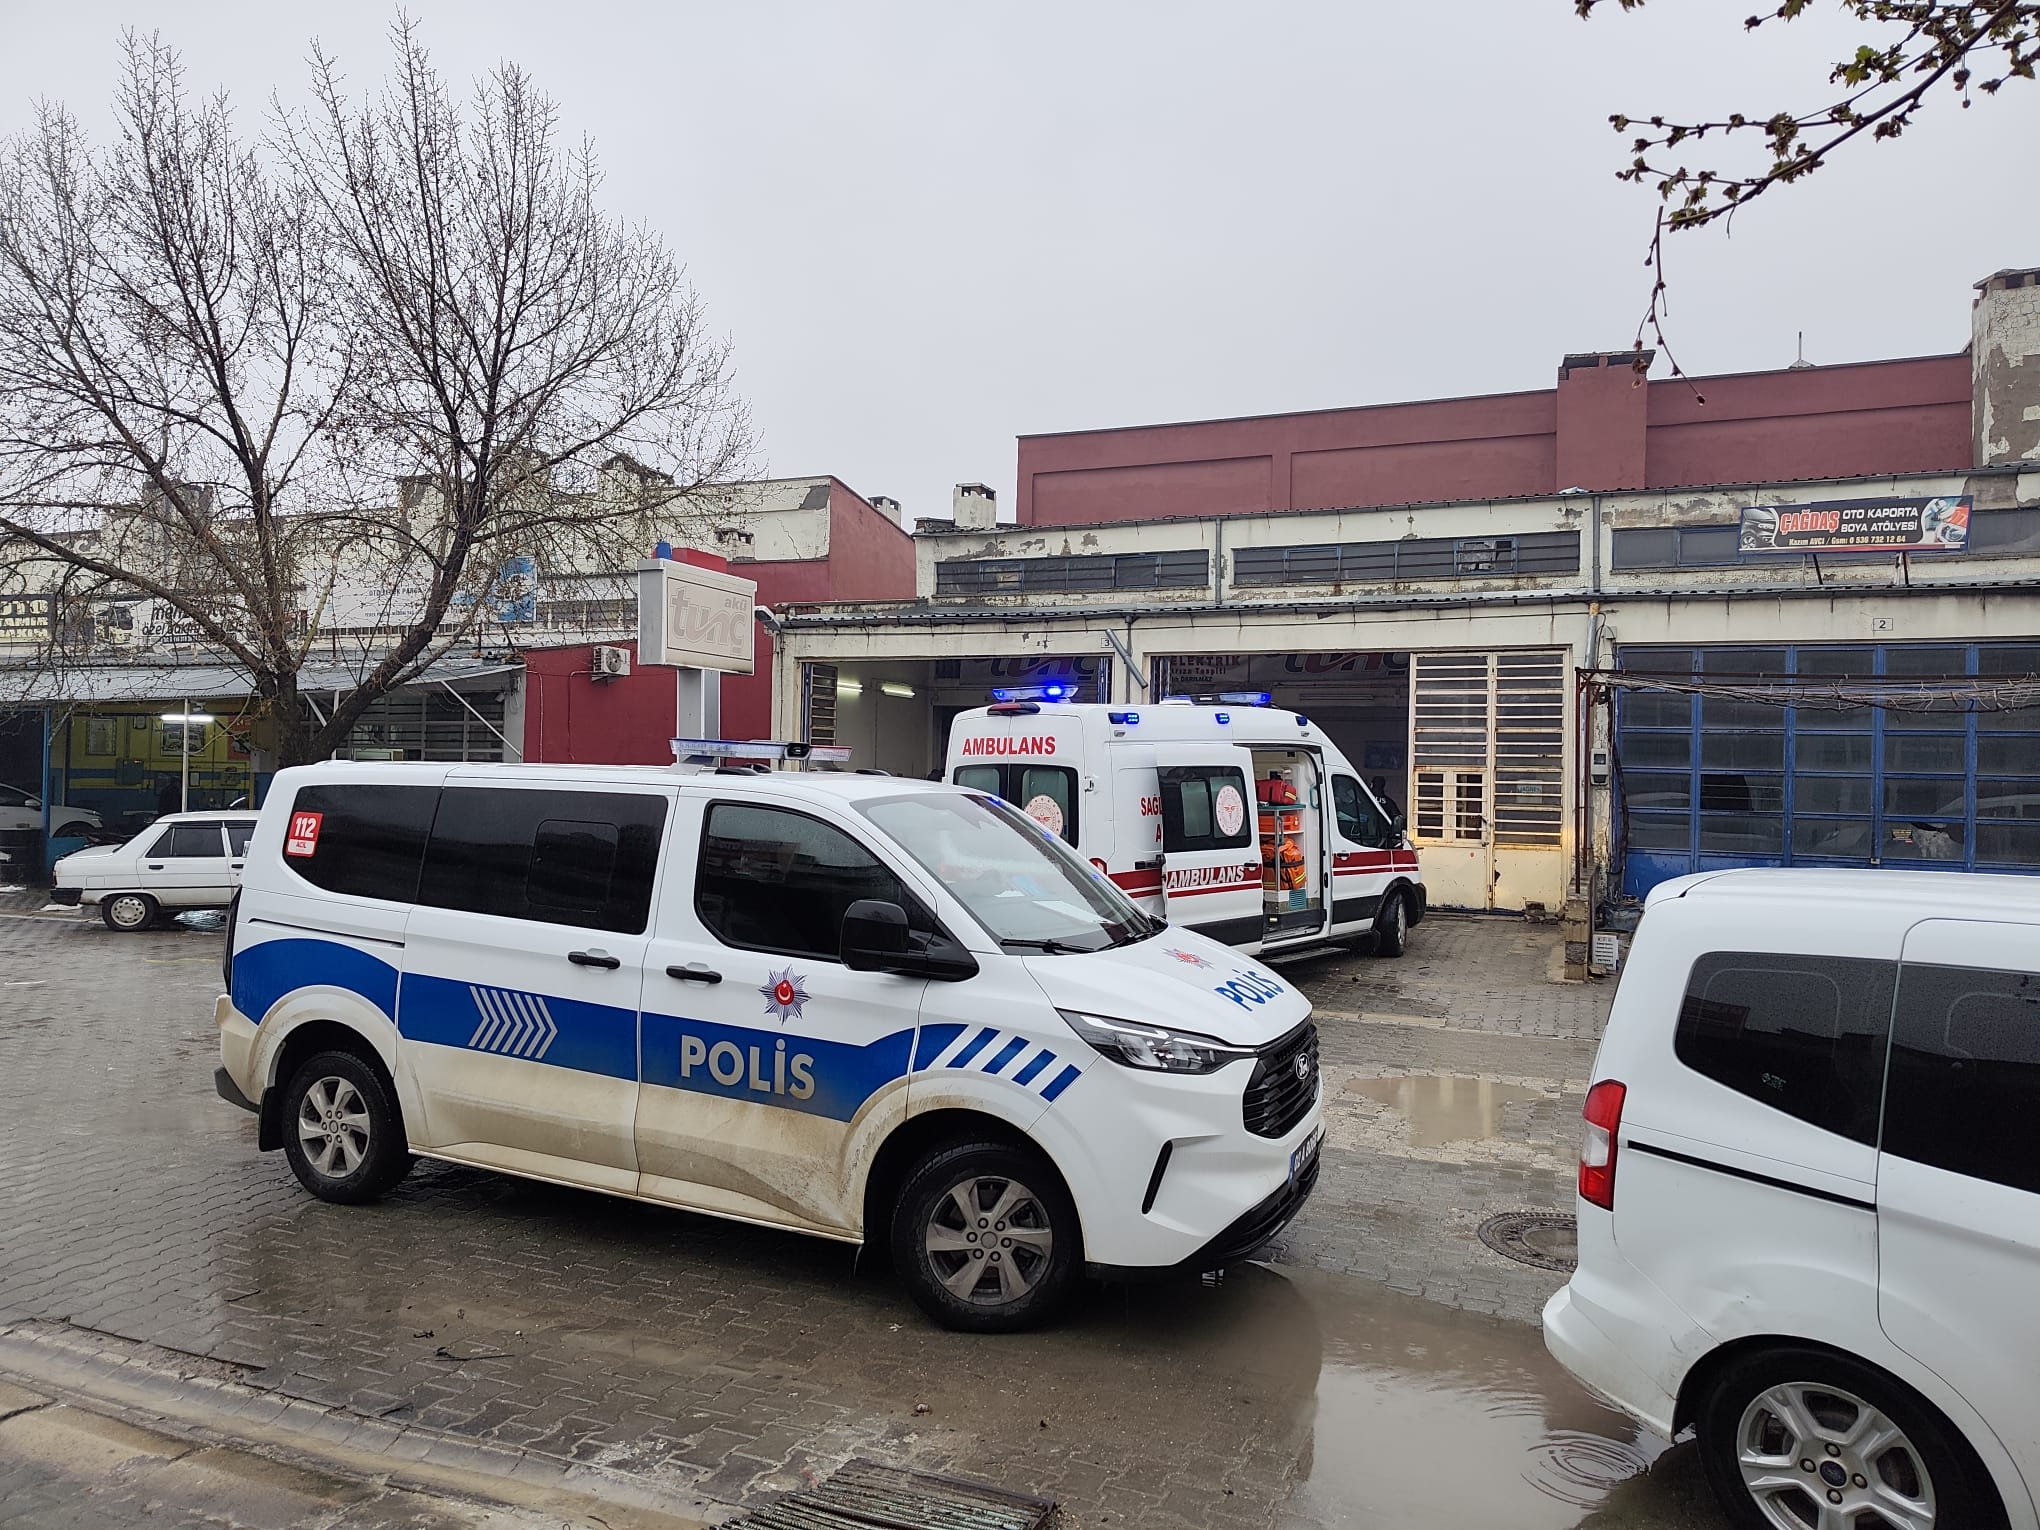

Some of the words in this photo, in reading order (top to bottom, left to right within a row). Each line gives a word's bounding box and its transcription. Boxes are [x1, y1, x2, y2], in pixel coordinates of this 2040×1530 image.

[1780, 508, 1840, 535] ÇAĞDAŞ
[1843, 510, 1865, 519] OTO
[1868, 507, 1919, 518] KAPORTA
[1841, 523, 1868, 532] BOYA
[1870, 519, 1918, 532] ATÖLYESİ
[1886, 535, 1895, 543] 12
[725, 598, 747, 611] akü
[671, 587, 745, 654] tunç
[1879, 619, 1887, 629] 2
[1104, 639, 1110, 647] 3
[962, 736, 1056, 756] AMBULANS
[294, 817, 317, 838] 112
[1167, 866, 1245, 889] AMBULANS
[1214, 968, 1284, 1012] POLİS
[680, 1034, 816, 1101] POLİS
